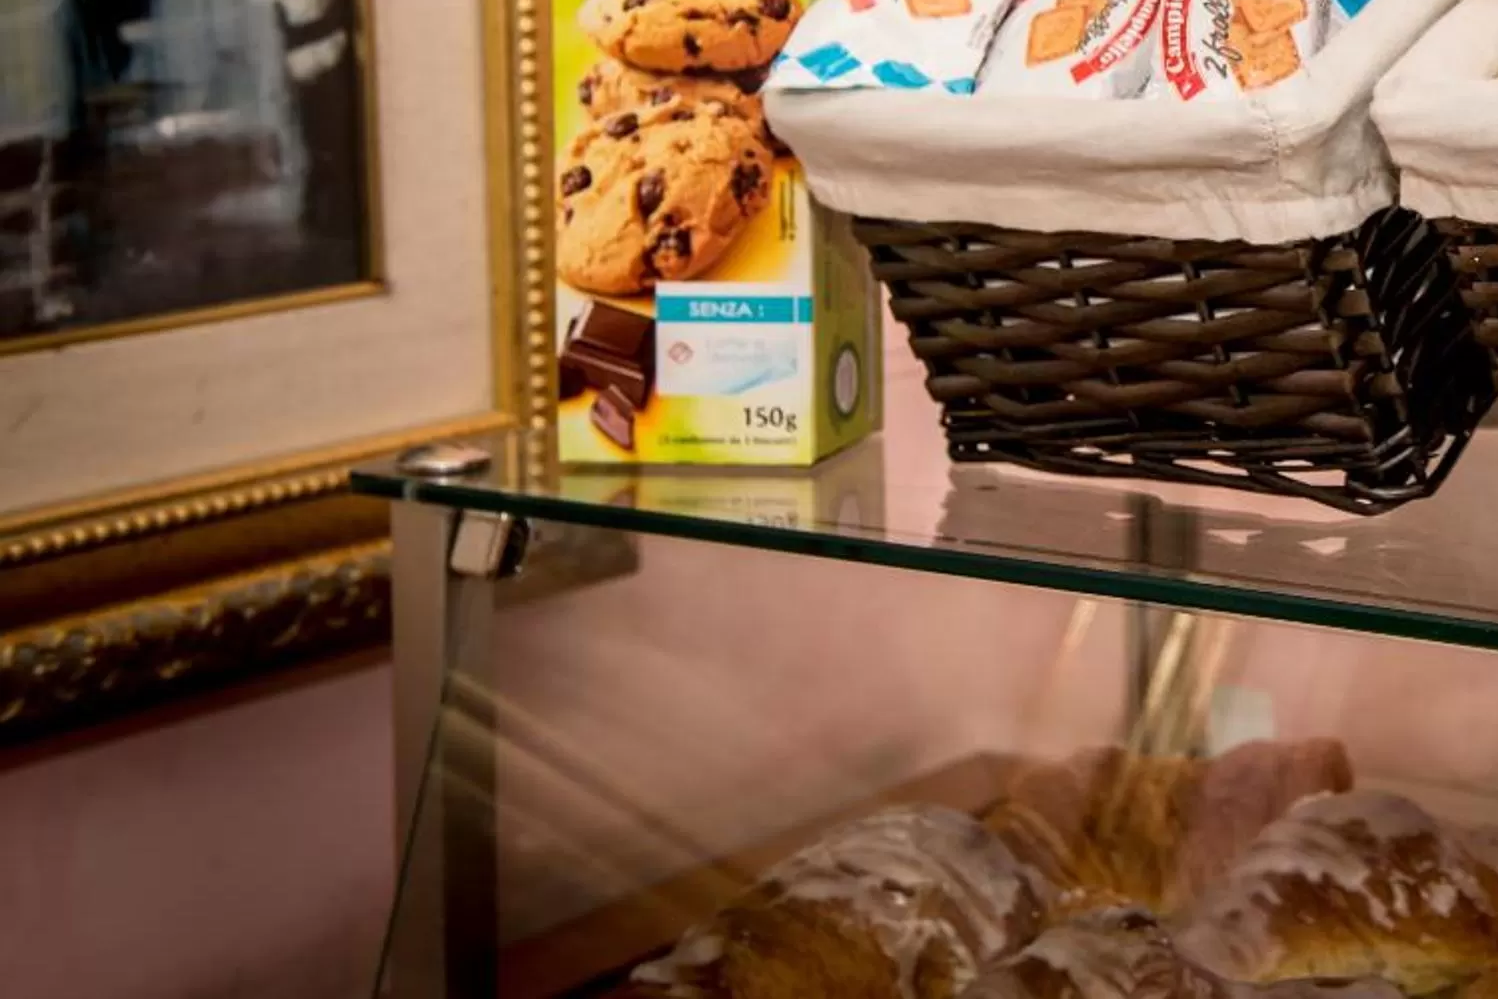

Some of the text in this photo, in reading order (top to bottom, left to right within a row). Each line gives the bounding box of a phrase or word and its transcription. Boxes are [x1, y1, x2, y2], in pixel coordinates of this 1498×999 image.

[1205, 56, 1228, 78] 2
[688, 301, 753, 317] SENZA
[743, 406, 797, 432] 150g
